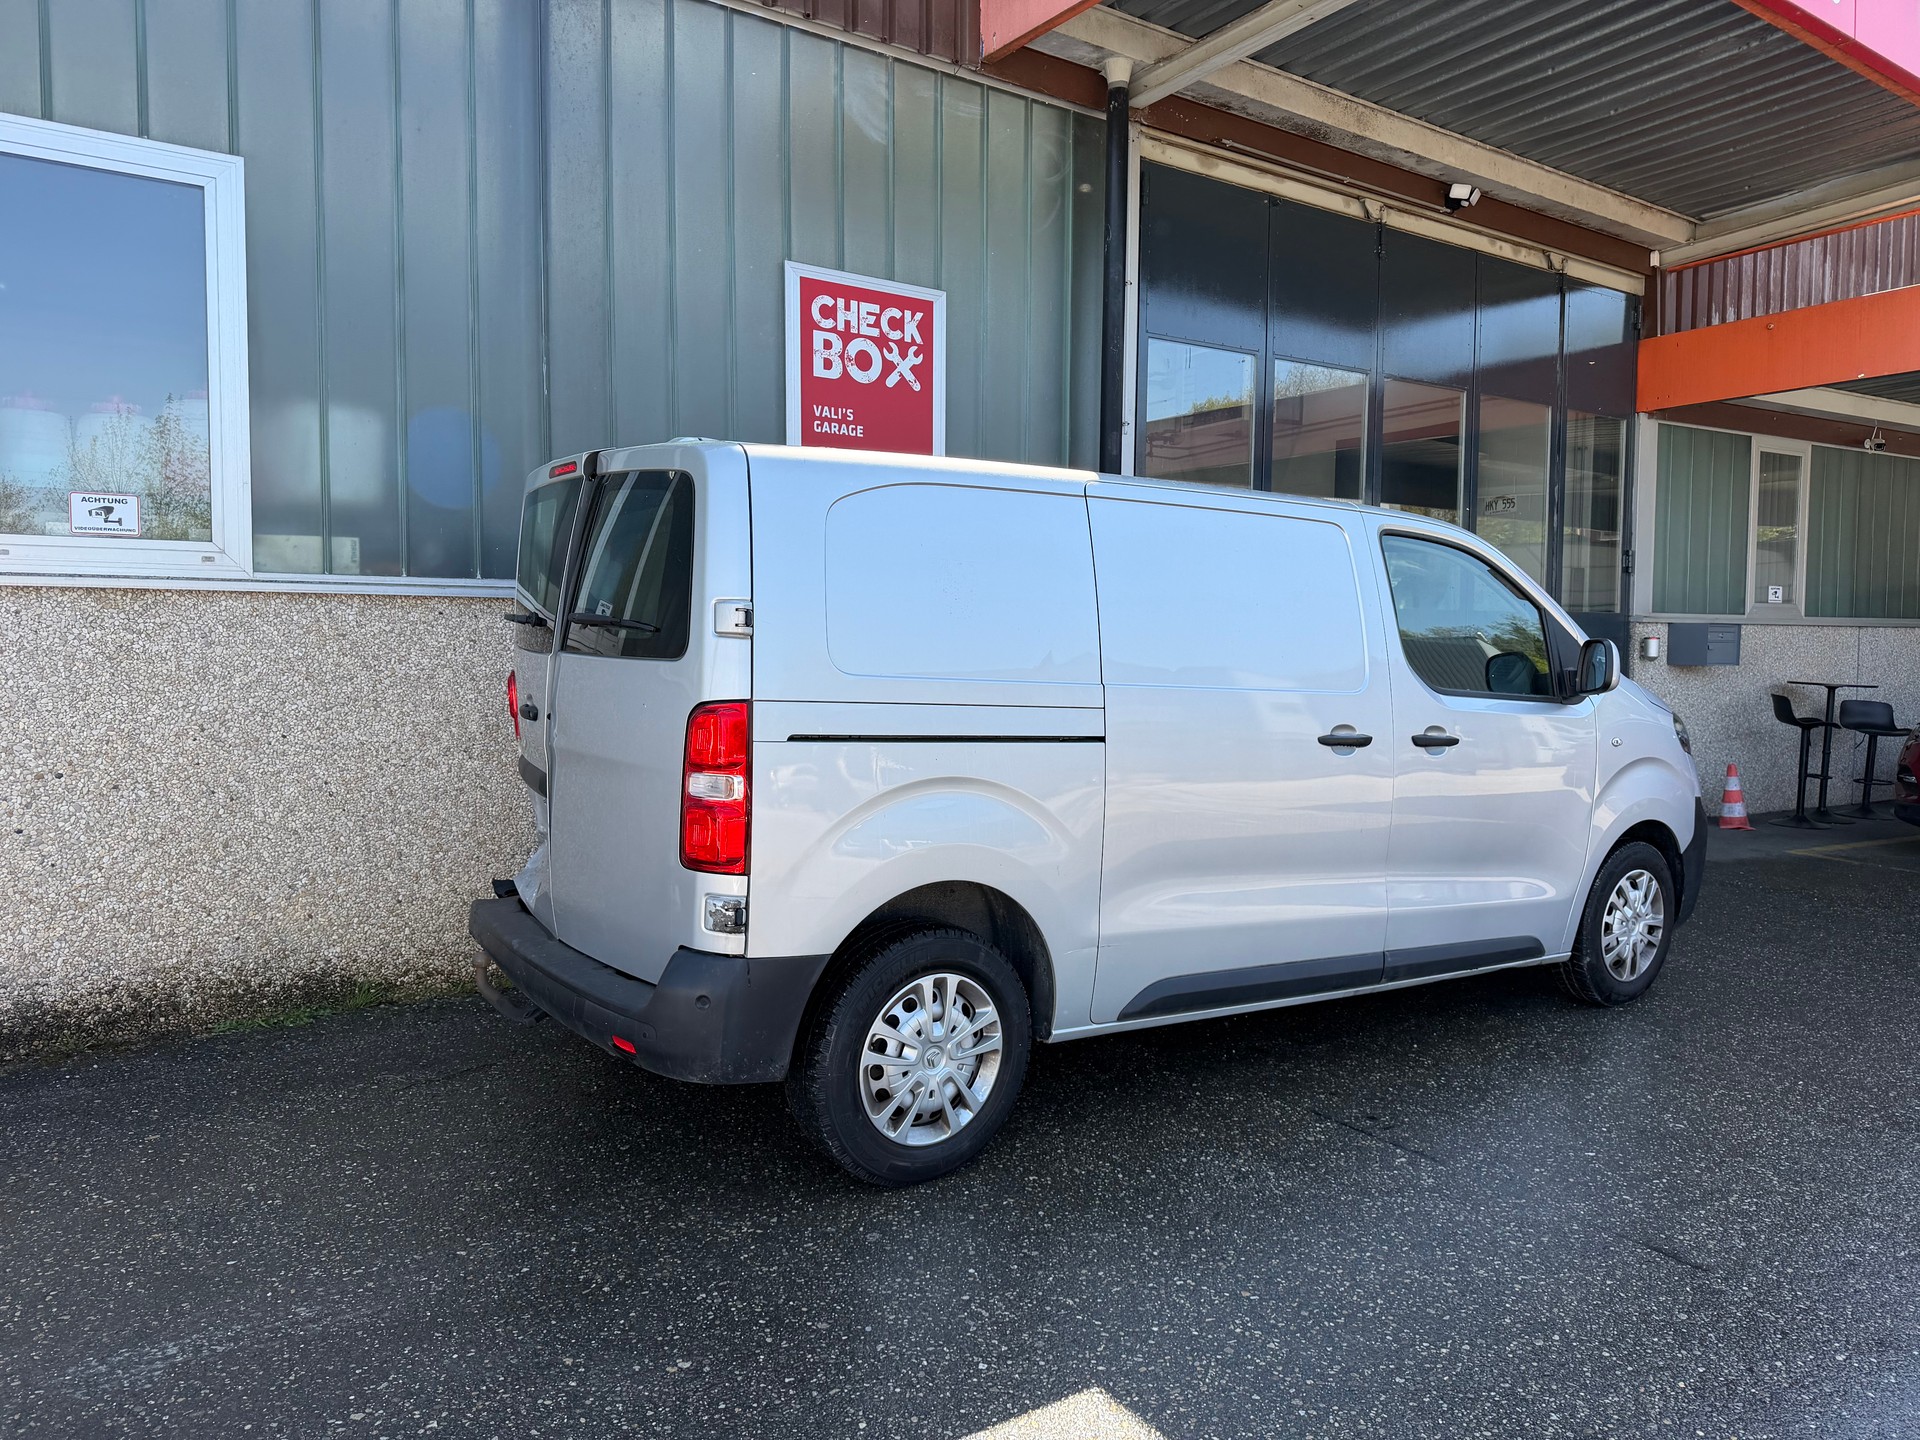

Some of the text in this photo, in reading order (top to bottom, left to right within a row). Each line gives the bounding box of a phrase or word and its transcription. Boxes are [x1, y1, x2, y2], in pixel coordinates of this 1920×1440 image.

[811, 294, 924, 345] CHECK
[812, 329, 924, 392] BOX
[813, 404, 854, 421] VALI'S
[813, 420, 864, 438] GARAGE
[81, 496, 128, 505] ACHTUNG
[1485, 498, 1516, 511] HKY 555
